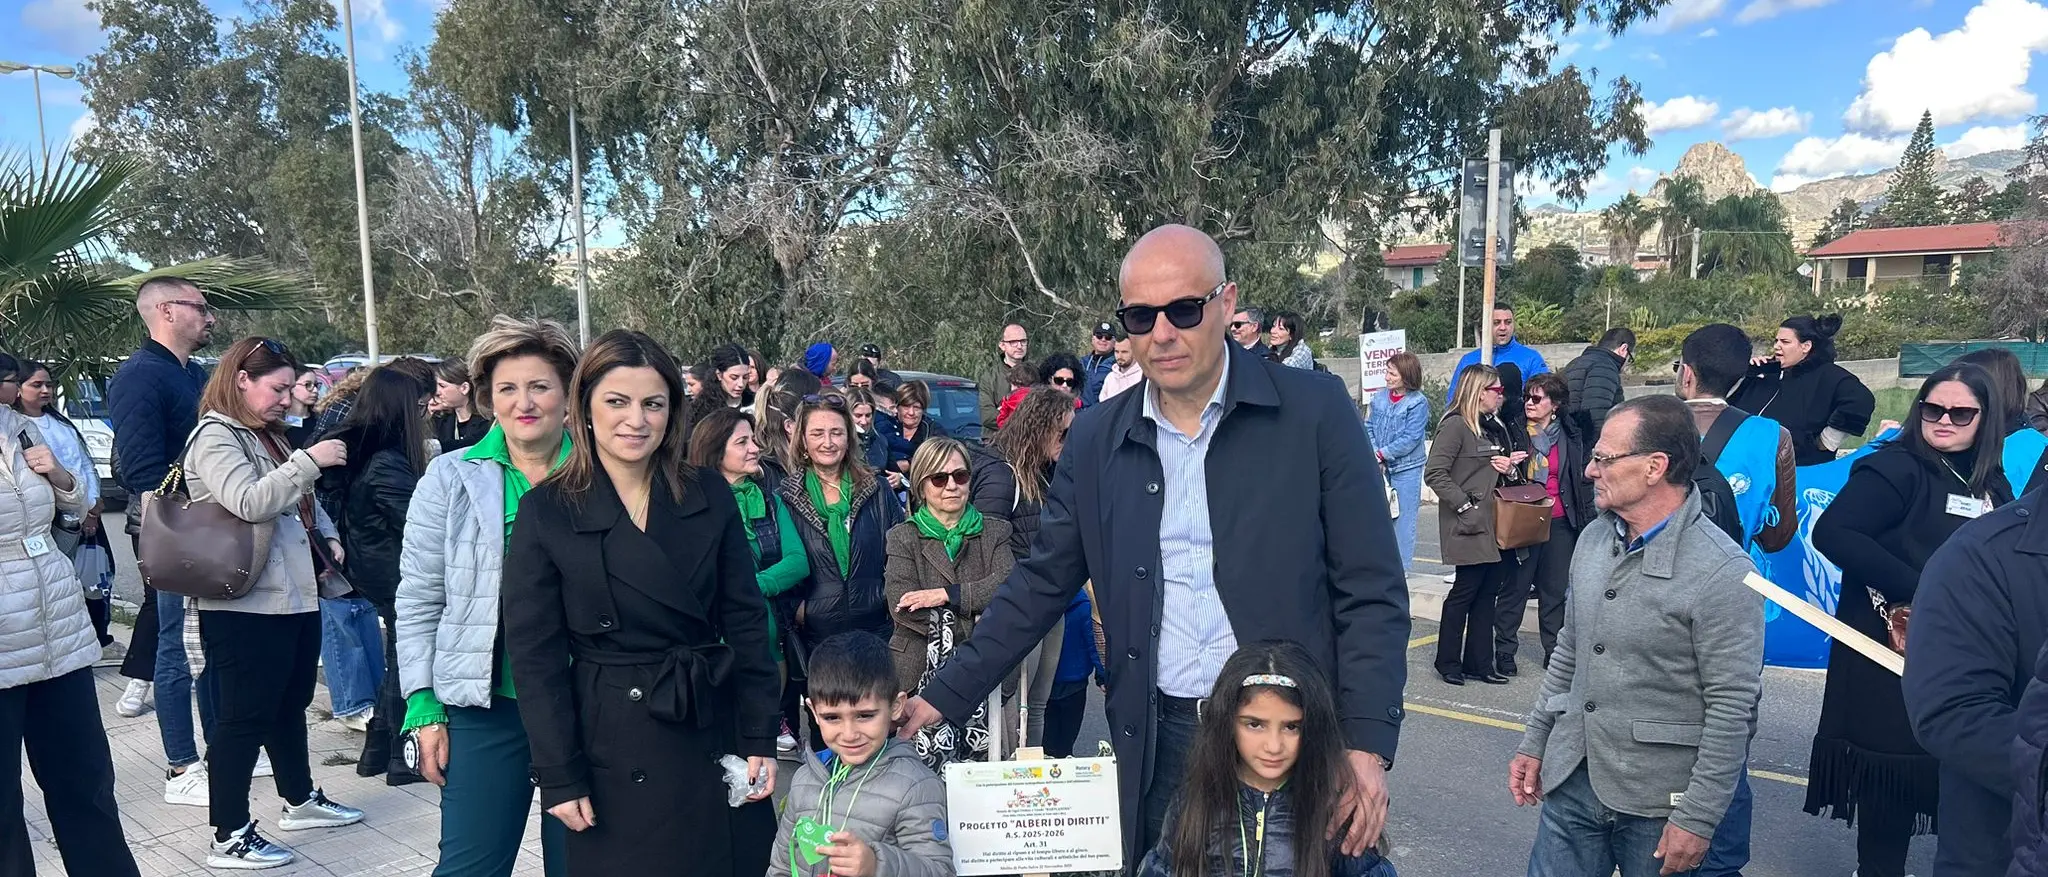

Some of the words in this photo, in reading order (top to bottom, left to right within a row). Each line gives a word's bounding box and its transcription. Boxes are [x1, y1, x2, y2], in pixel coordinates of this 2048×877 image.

[1365, 360, 1387, 369] TERR
[1054, 818, 1064, 826] DI
[1022, 830, 1064, 838] 2025-2026
